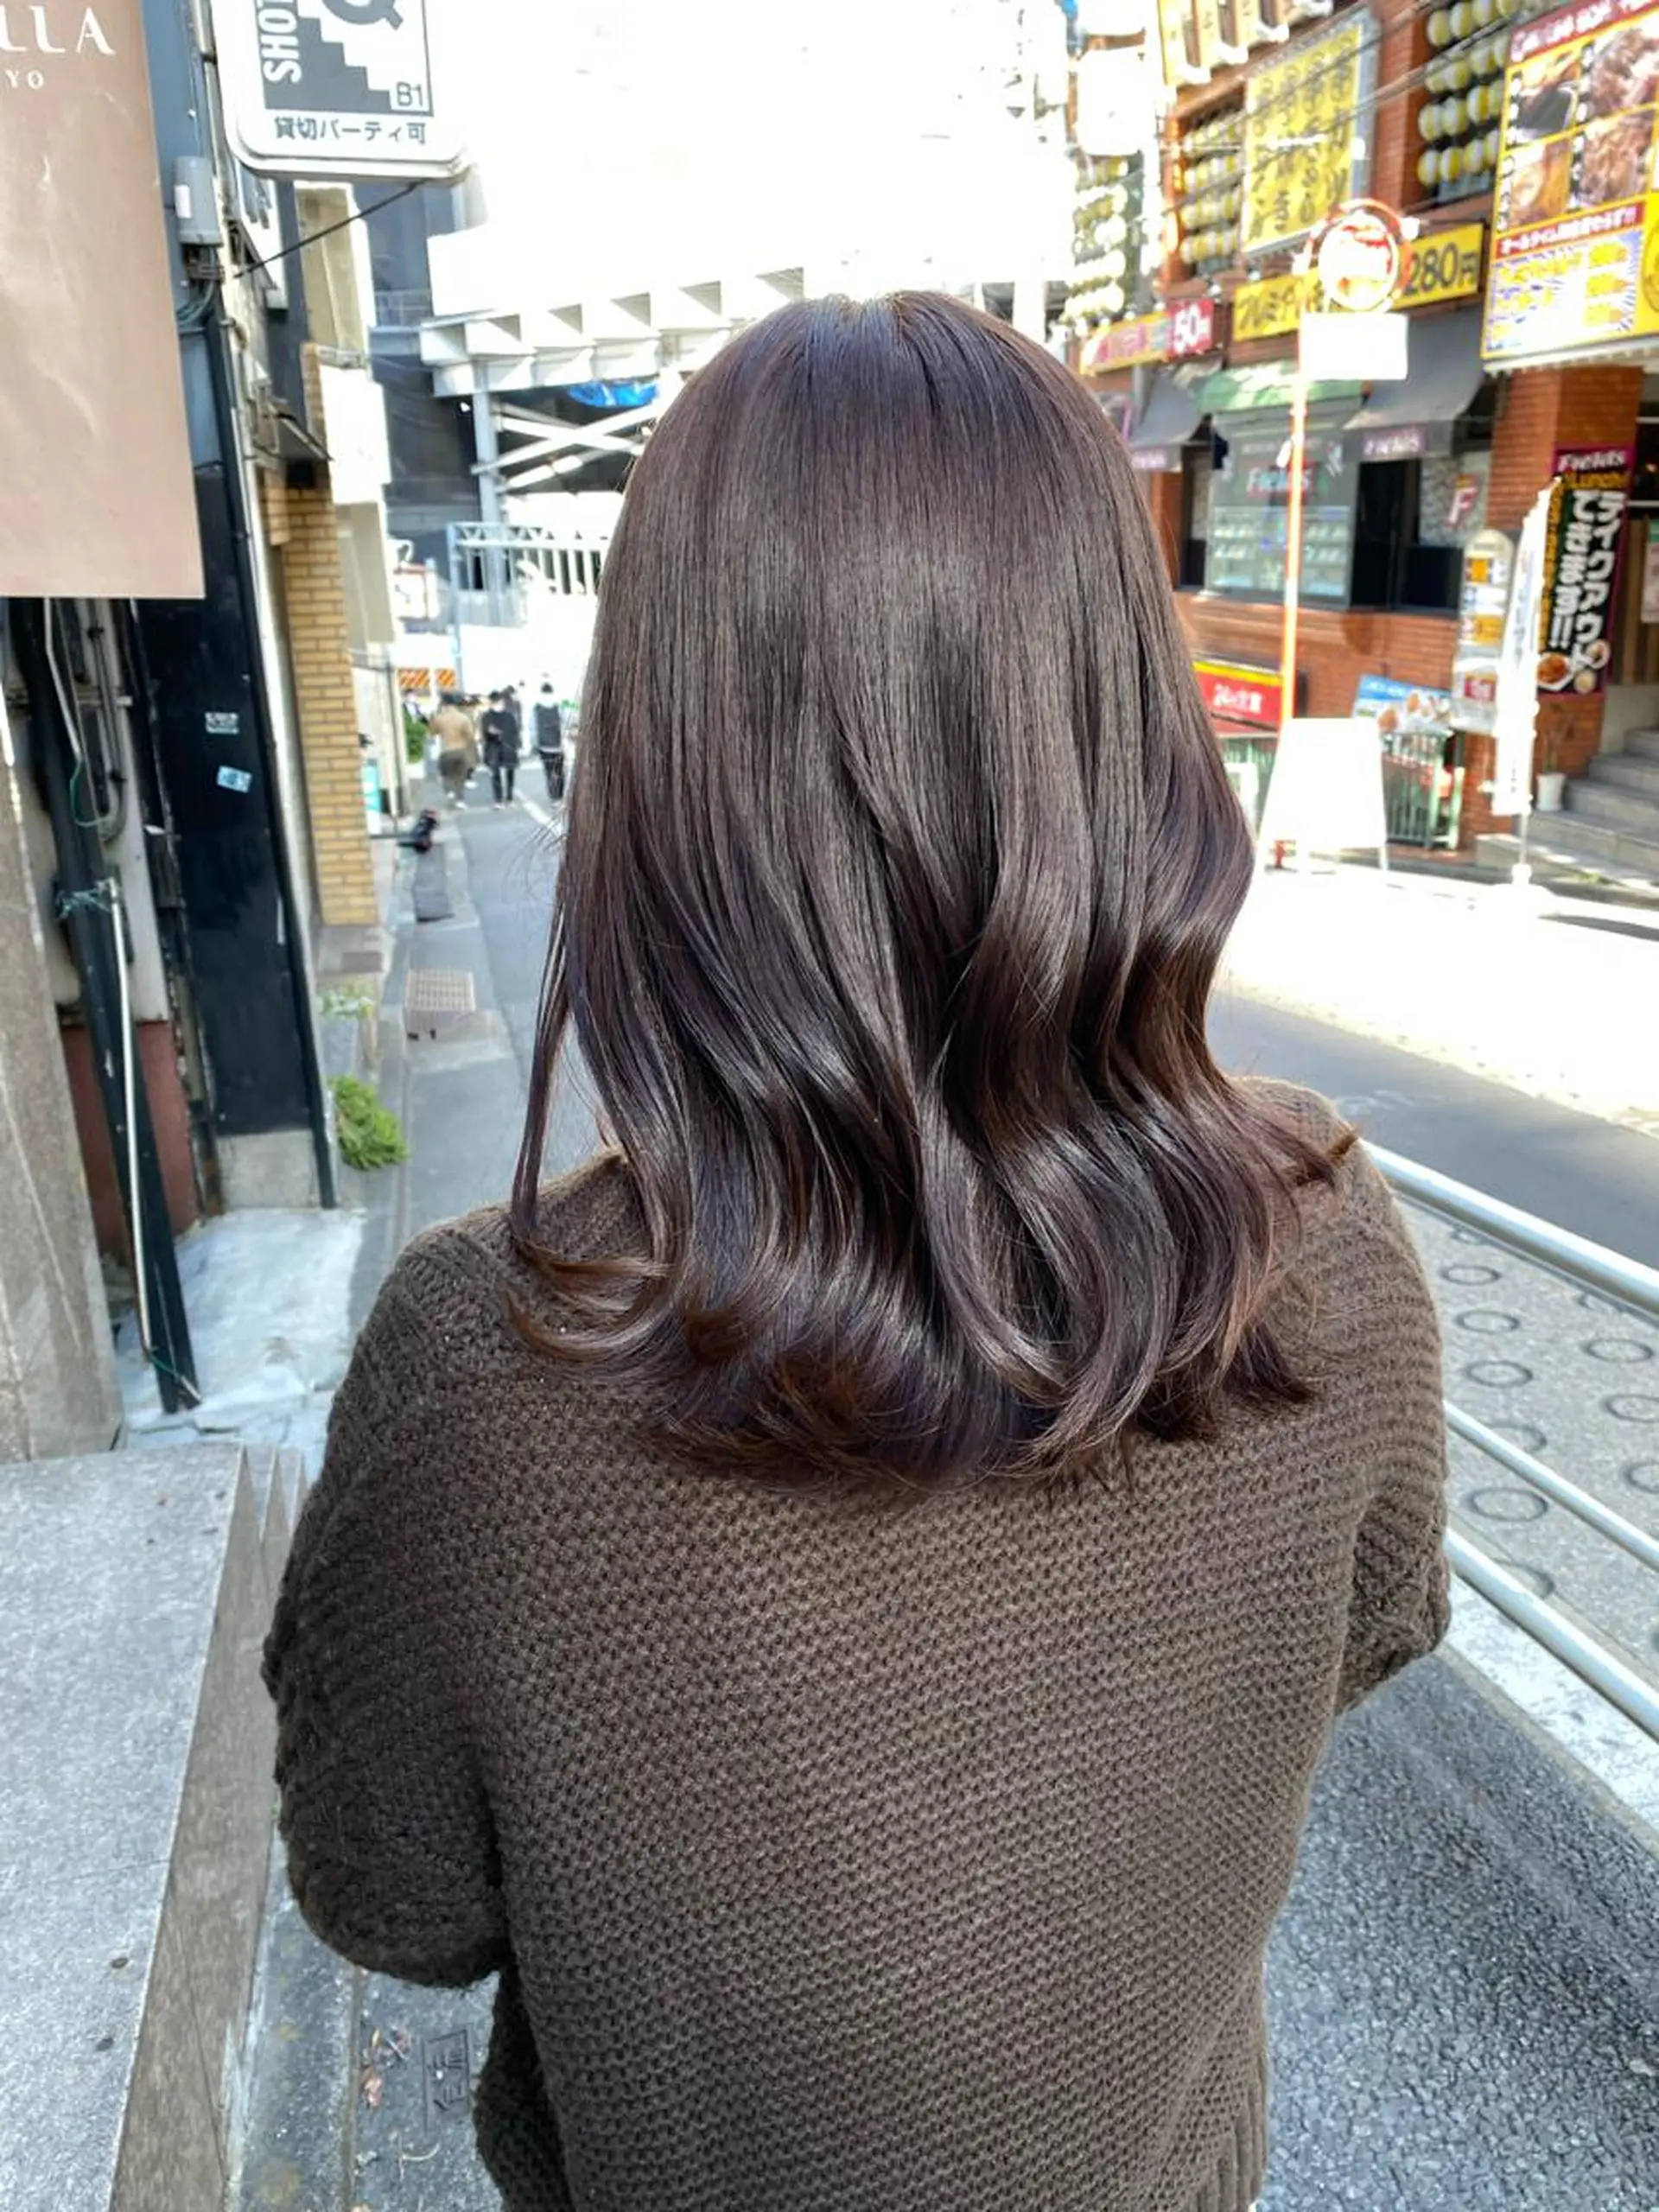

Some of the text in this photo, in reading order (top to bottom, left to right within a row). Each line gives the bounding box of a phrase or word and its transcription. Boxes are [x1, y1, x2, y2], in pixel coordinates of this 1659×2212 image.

[4, 68, 45, 90] YO
[396, 81, 423, 107] B1
[274, 116, 426, 144] 貸切パーティ可
